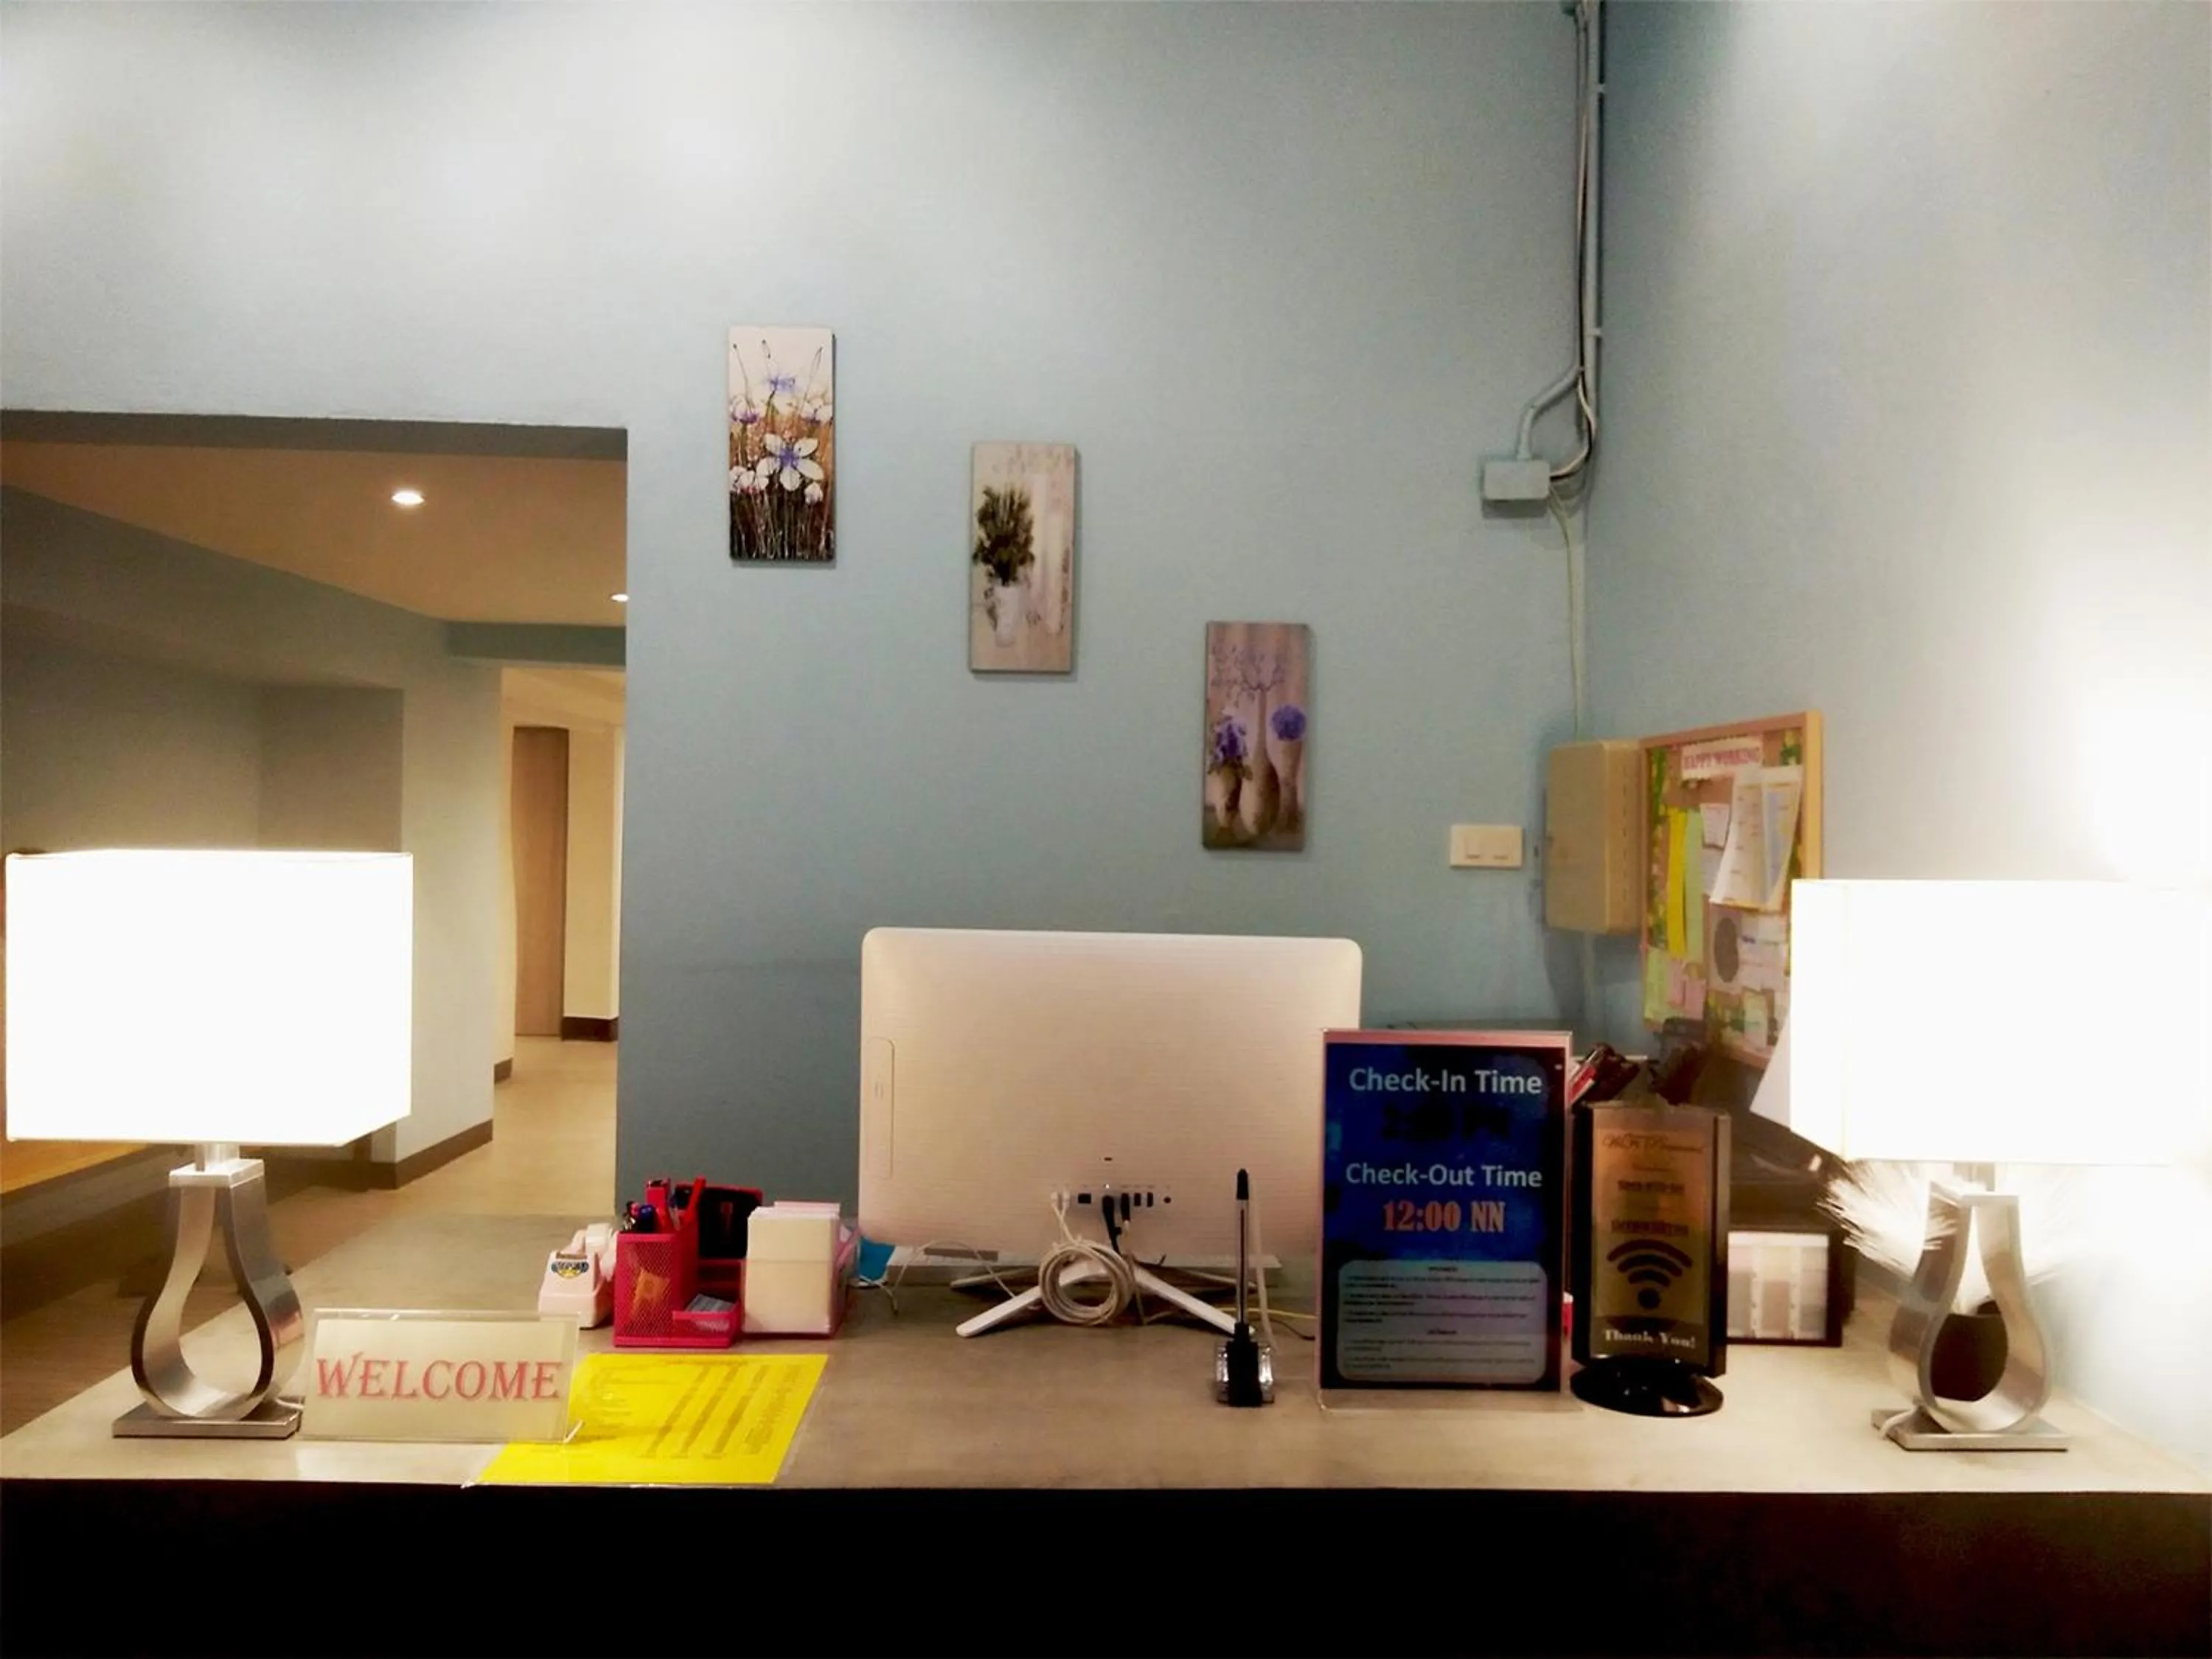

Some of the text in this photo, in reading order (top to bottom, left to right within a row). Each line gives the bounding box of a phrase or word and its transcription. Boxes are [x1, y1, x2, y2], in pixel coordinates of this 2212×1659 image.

[1349, 1067, 1543, 1094] Check-In Time
[1346, 1163, 1543, 1188] Check-Out Time
[1382, 1200, 1506, 1233] 12:00 NN
[1605, 1328, 1695, 1349] Thank You!
[316, 1351, 563, 1400] WELCOME
